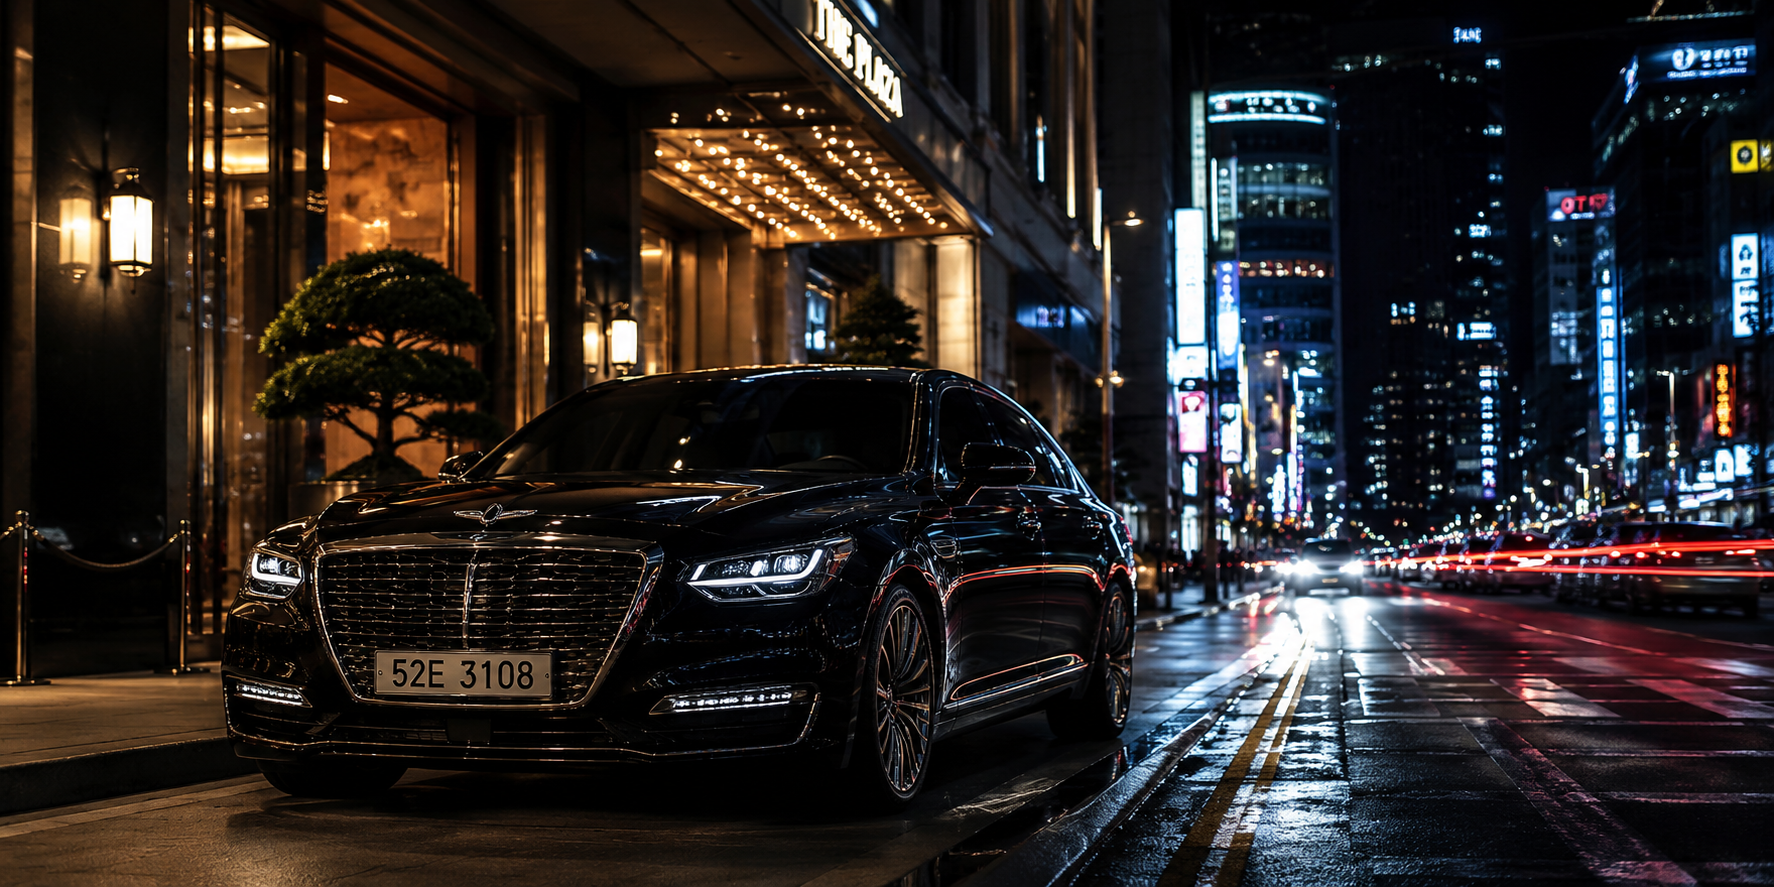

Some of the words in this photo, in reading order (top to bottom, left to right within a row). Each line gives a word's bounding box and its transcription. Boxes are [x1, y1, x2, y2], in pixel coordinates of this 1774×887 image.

[813, 0, 853, 69] THE
[853, 33, 903, 118] PLAZA
[392, 659, 445, 688] 52E
[460, 660, 534, 689] 3108
